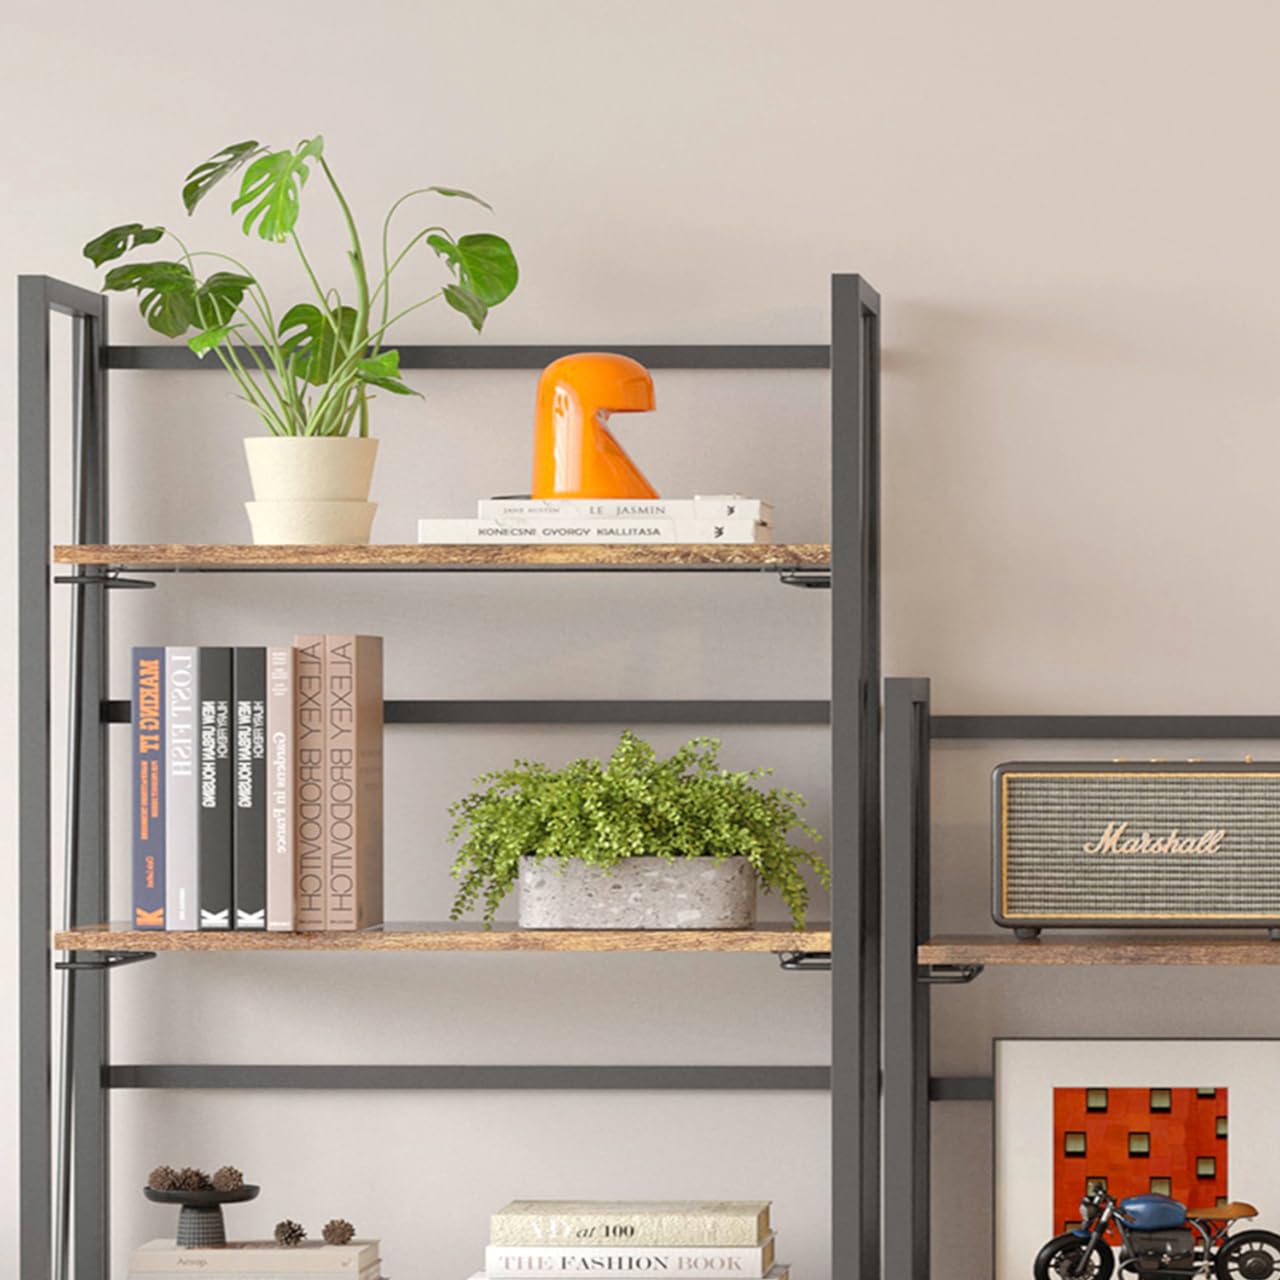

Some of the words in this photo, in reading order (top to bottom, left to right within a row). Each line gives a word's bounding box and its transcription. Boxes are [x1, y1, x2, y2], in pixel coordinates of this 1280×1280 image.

[589, 505, 604, 516] LE
[615, 505, 667, 516] JASMIN
[478, 527, 538, 537] KONECSNI
[1083, 821, 1227, 855] Marshall
[576, 1226, 596, 1239] at
[604, 1225, 635, 1238] 100
[500, 1255, 552, 1271] THE
[561, 1255, 670, 1271] FASHION
[676, 1255, 743, 1271] BOOK
